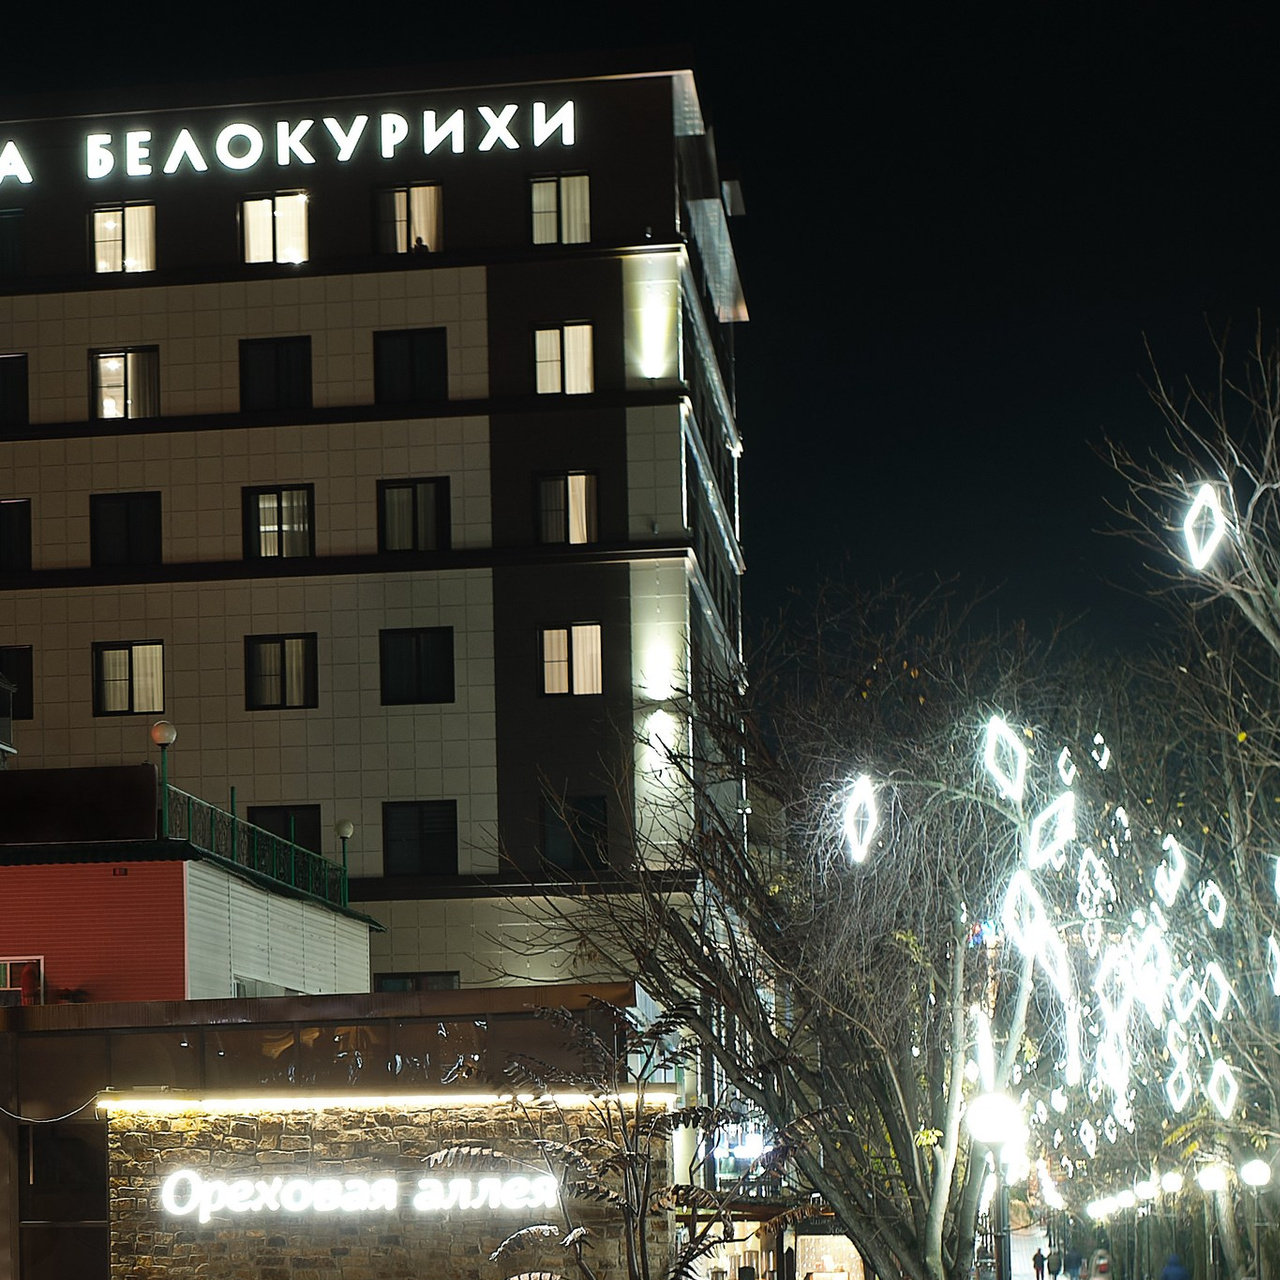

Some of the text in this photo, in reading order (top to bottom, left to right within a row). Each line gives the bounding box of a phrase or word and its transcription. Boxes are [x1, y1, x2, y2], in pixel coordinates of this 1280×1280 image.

[86, 100, 576, 180] БЕЛОКУРИХИ
[161, 1169, 561, 1223] Ореховая аллея
